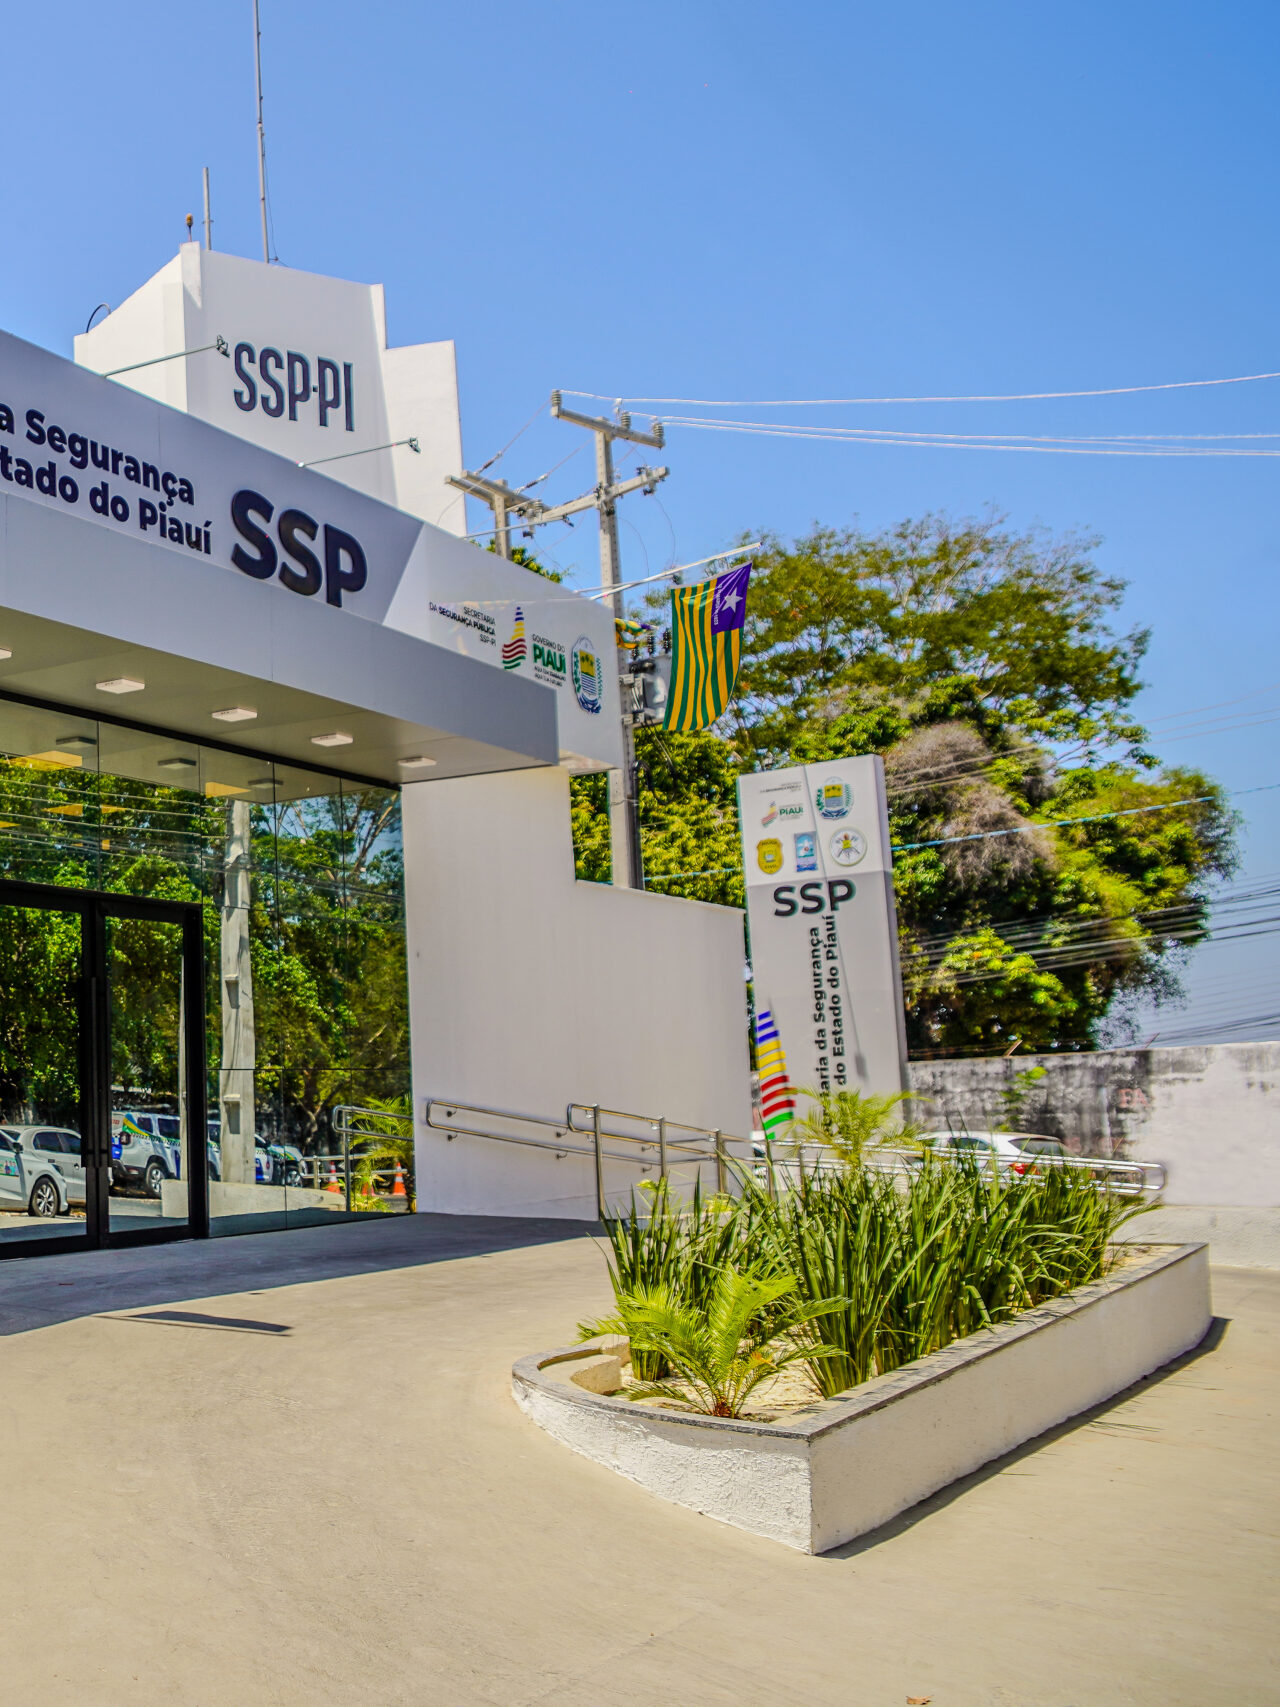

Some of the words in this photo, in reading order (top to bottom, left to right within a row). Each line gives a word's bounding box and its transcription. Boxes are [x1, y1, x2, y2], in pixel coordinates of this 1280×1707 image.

[233, 341, 355, 432] SSP-PI
[25, 408, 195, 507] Segurança
[89, 481, 130, 523] do
[138, 497, 213, 555] Piauí
[231, 489, 368, 608] SSP
[429, 601, 438, 612] DA
[438, 606, 473, 628] SEGURANÇA
[463, 606, 496, 626] SECRETARIA
[532, 633, 557, 650] GOVERNO
[557, 643, 566, 653] DO
[773, 879, 855, 917] SSP
[822, 915, 838, 961] Piauí
[809, 927, 827, 1022] Segurança
[827, 966, 840, 989] do
[815, 1028, 828, 1050] da
[829, 994, 845, 1056] Estado
[833, 1062, 847, 1086] do
